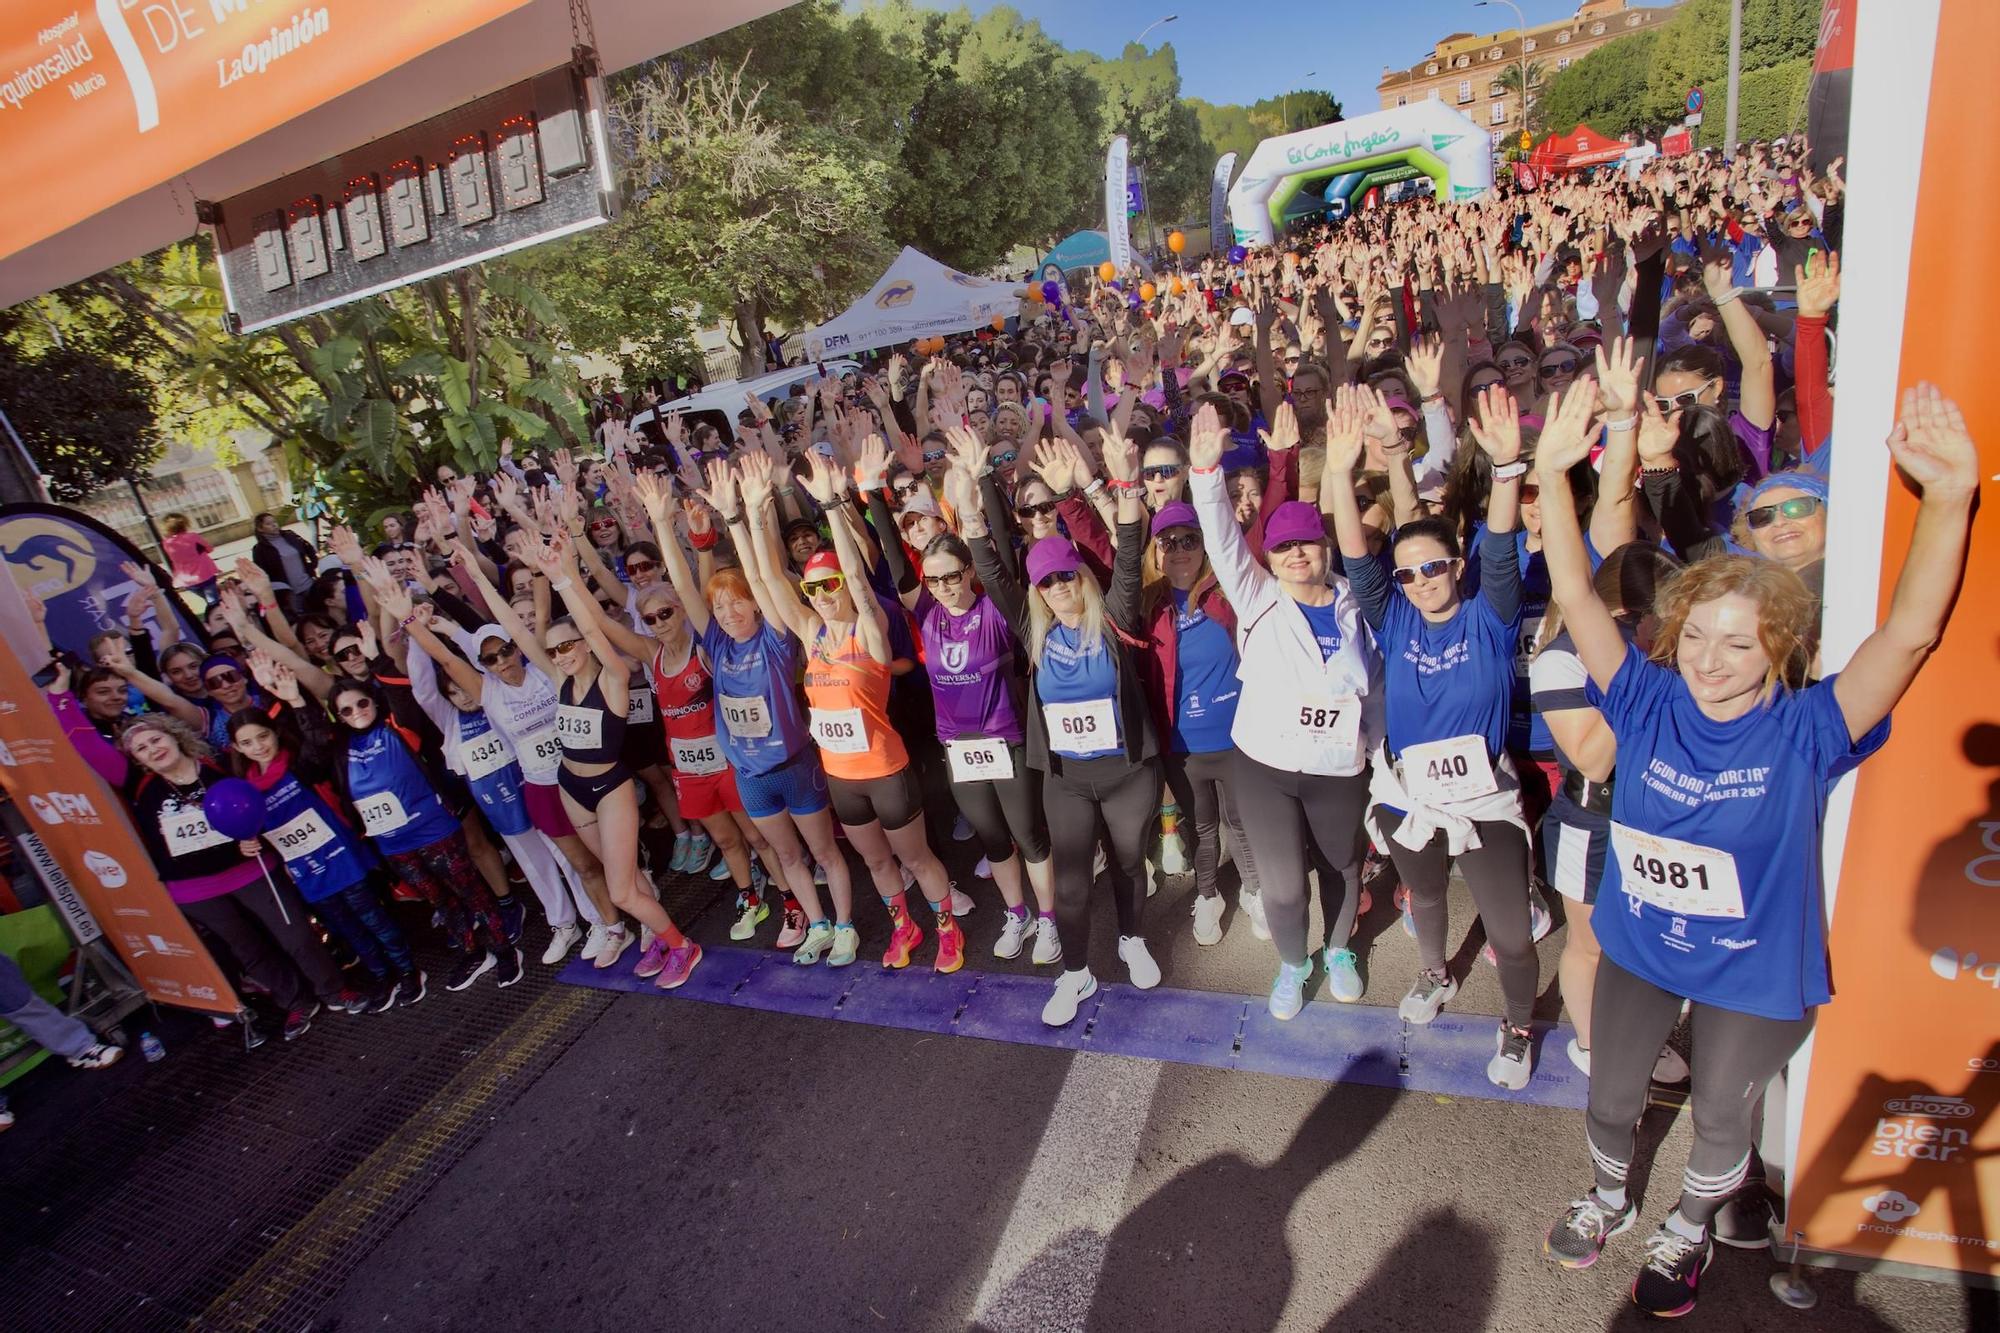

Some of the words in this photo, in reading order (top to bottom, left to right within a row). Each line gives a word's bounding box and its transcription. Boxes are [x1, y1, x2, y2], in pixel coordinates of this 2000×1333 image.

[37, 10, 79, 46] Hospital
[142, 0, 205, 53] DE
[217, 7, 330, 88] LaOpinión
[67, 72, 107, 101] Murcia
[1287, 146, 1303, 164] El
[1304, 140, 1342, 159] Corte
[1343, 127, 1400, 158] Inglés
[824, 333, 850, 348] DFM
[558, 716, 592, 735] 3133
[725, 707, 760, 722] 1015
[1062, 715, 1097, 734] 603
[1300, 706, 1341, 728] 587
[818, 722, 854, 738] 1803
[472, 739, 504, 762] 4347
[536, 737, 563, 758] 839
[679, 747, 715, 764] 3545
[964, 750, 994, 766] 696
[1427, 755, 1468, 780] 440
[1703, 787, 1739, 802] MUJER
[278, 822, 317, 848] 3094
[1633, 853, 1709, 890] 4981
[27, 833, 95, 938] www.leitsport.es
[1876, 1117, 1969, 1145] bien
[1872, 1138, 1960, 1162] star
[1877, 1200, 1905, 1212] pb
[1857, 1223, 1999, 1249] probeltepharma
